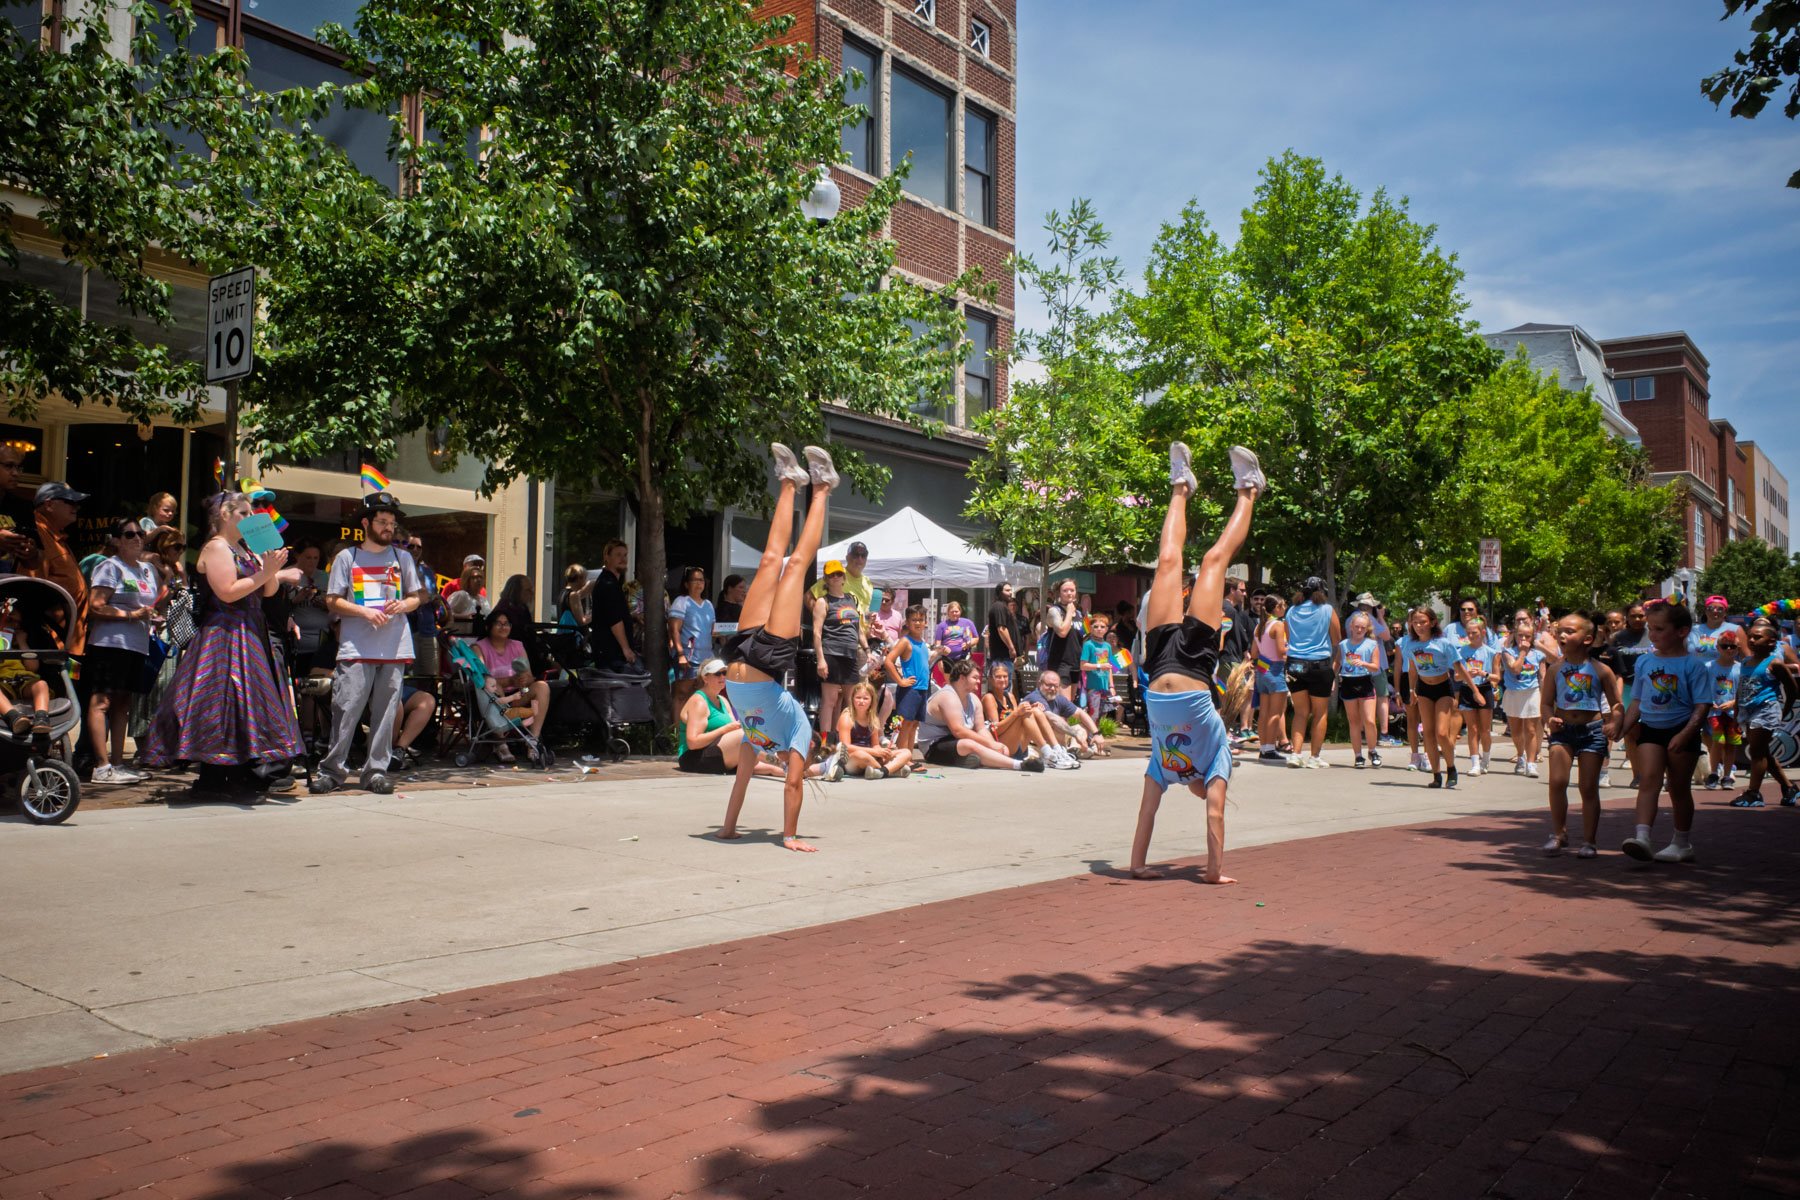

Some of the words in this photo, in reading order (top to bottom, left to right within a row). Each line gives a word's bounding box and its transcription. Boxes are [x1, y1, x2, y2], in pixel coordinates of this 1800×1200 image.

[211, 280, 250, 303] SPEED
[214, 303, 245, 325] LIMIT
[215, 327, 245, 369] 10
